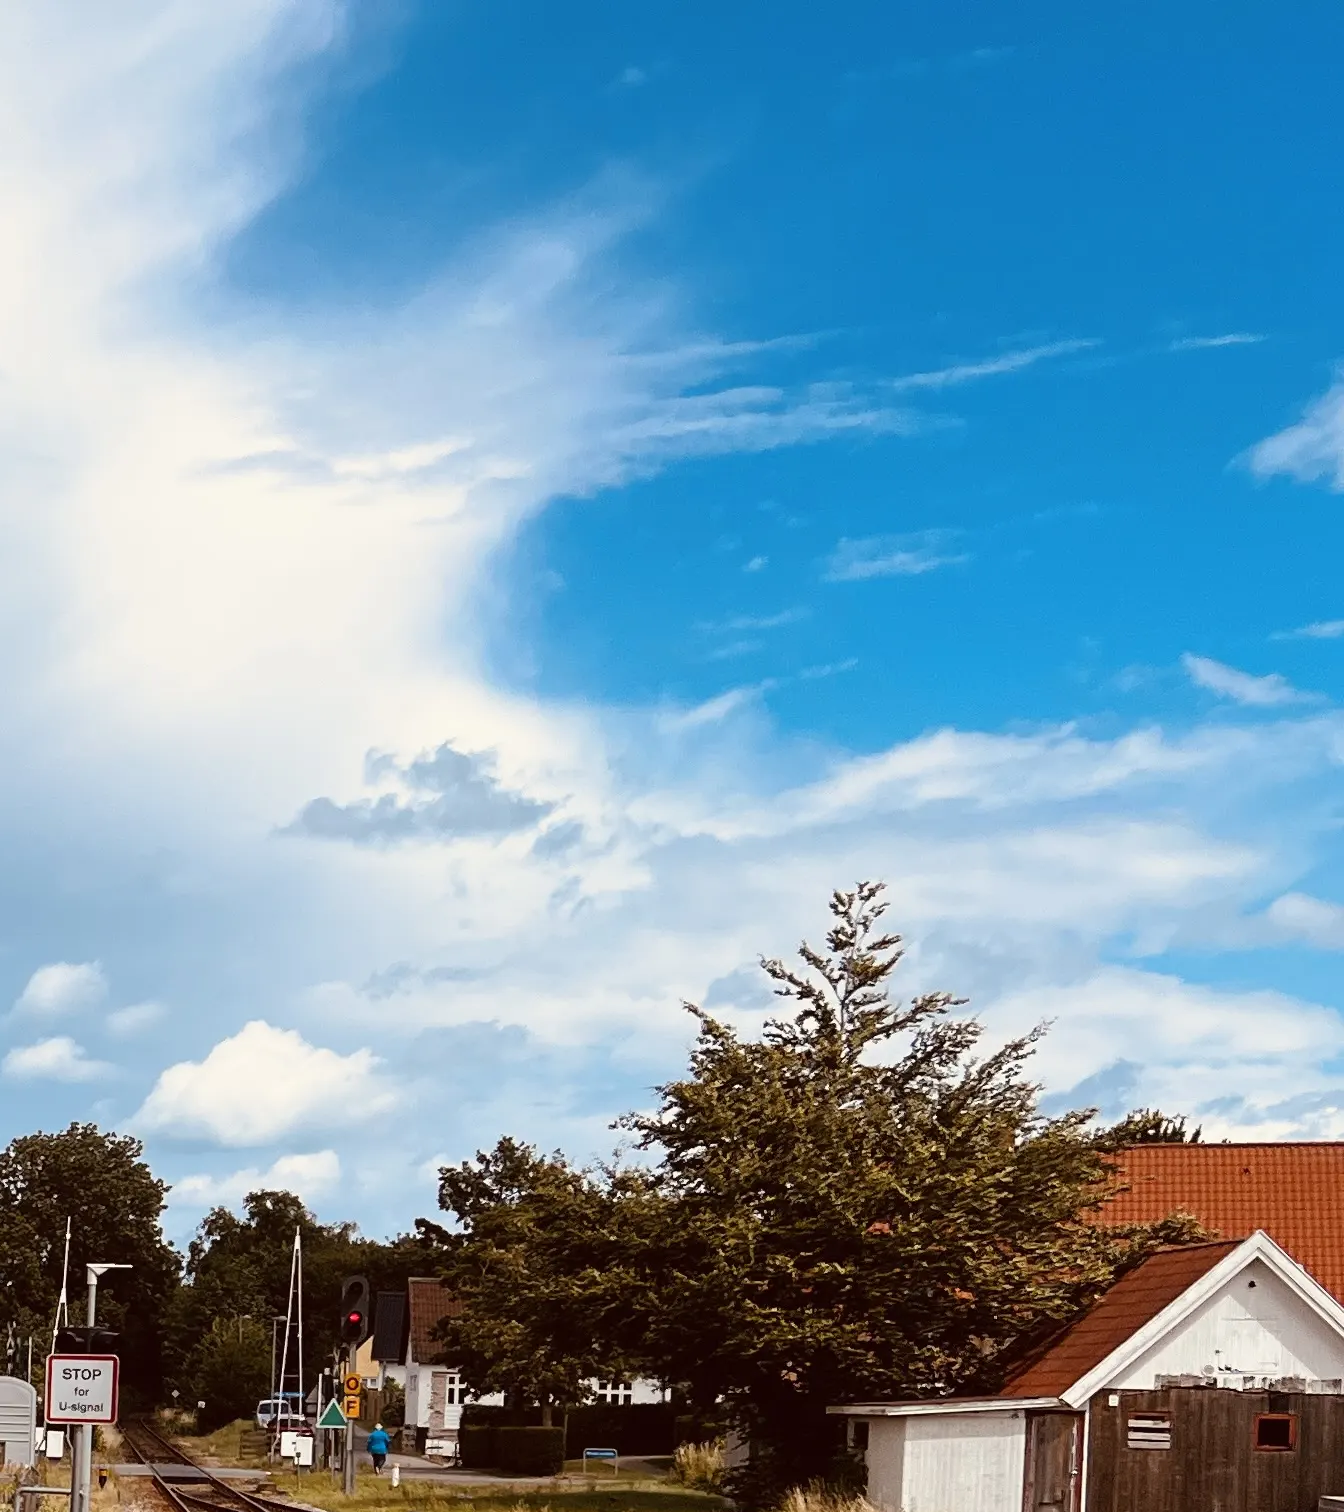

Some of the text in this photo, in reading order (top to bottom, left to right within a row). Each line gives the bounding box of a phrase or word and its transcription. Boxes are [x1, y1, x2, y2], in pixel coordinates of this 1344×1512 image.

[62, 1368, 102, 1380] STOP
[346, 1377, 359, 1391] O
[74, 1386, 89, 1396] for
[59, 1401, 104, 1413] U-signal
[346, 1400, 357, 1413] F
